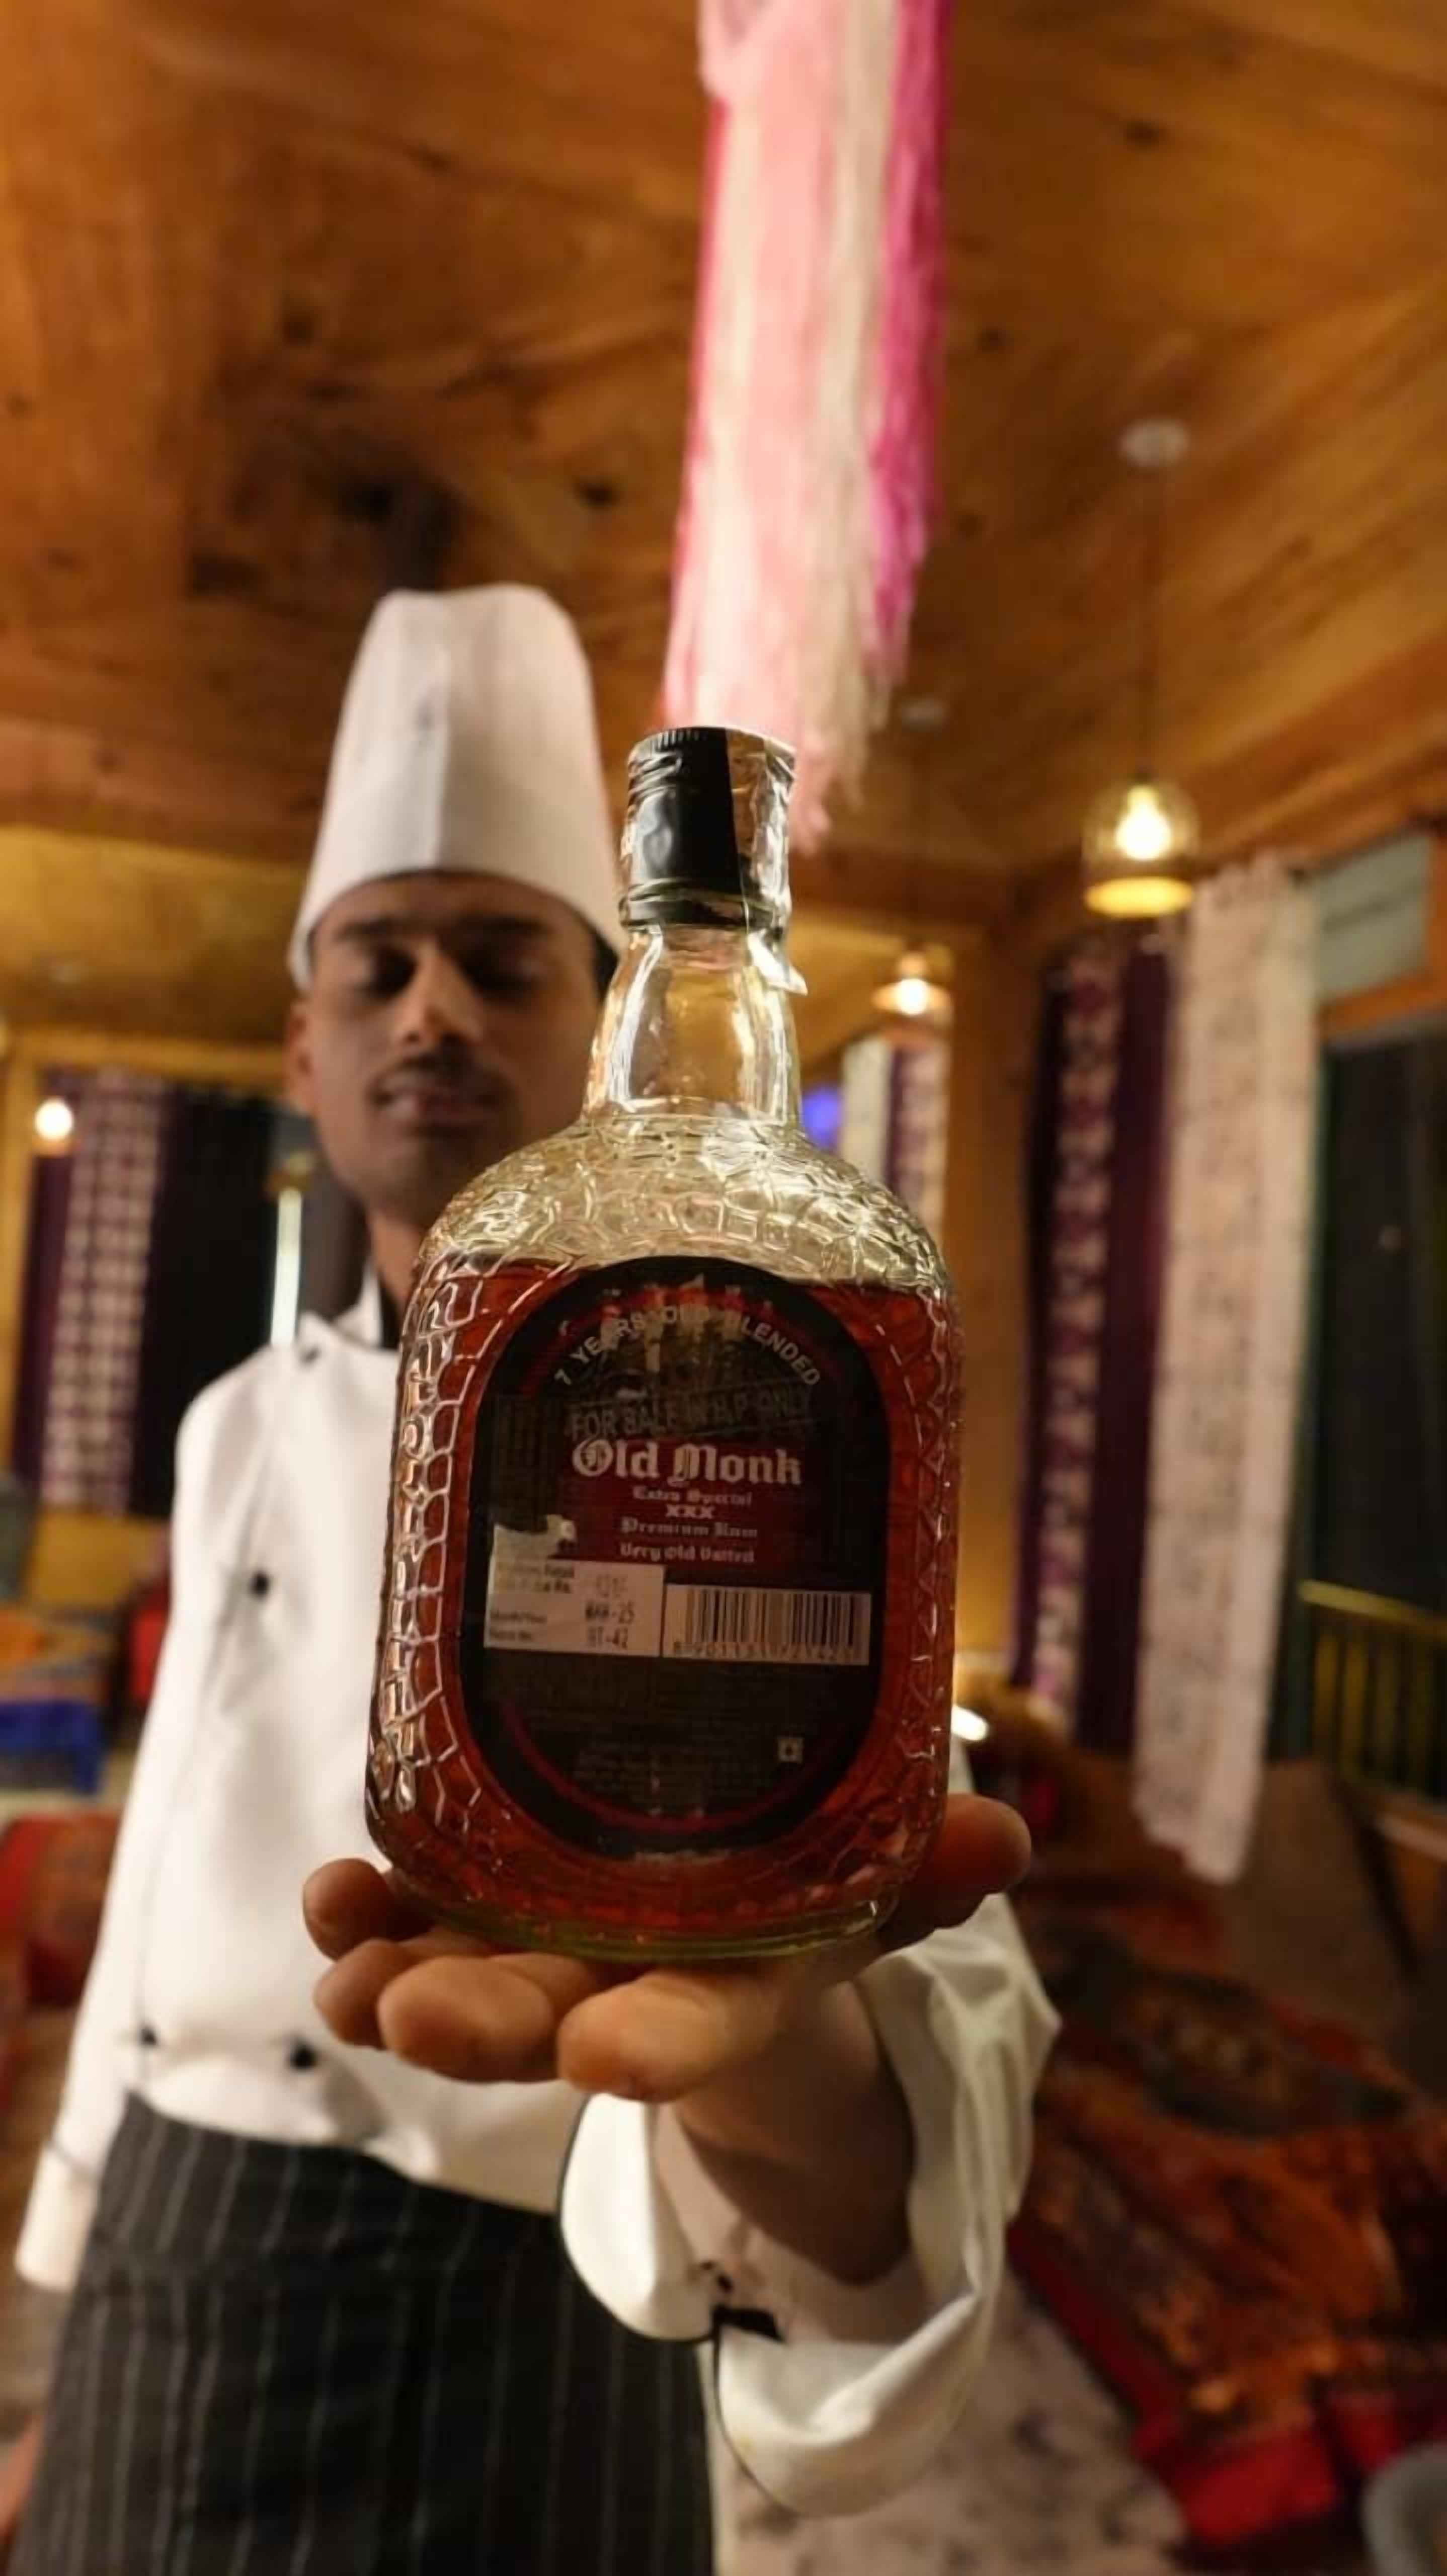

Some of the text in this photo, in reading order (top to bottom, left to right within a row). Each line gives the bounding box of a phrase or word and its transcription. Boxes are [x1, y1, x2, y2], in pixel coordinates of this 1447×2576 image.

[554, 1369, 572, 1385] 7
[572, 1436, 803, 1488] Old Monk
[665, 1504, 715, 1519] XXX
[620, 1516, 709, 1537] Premium
[620, 1542, 661, 1562] Very
